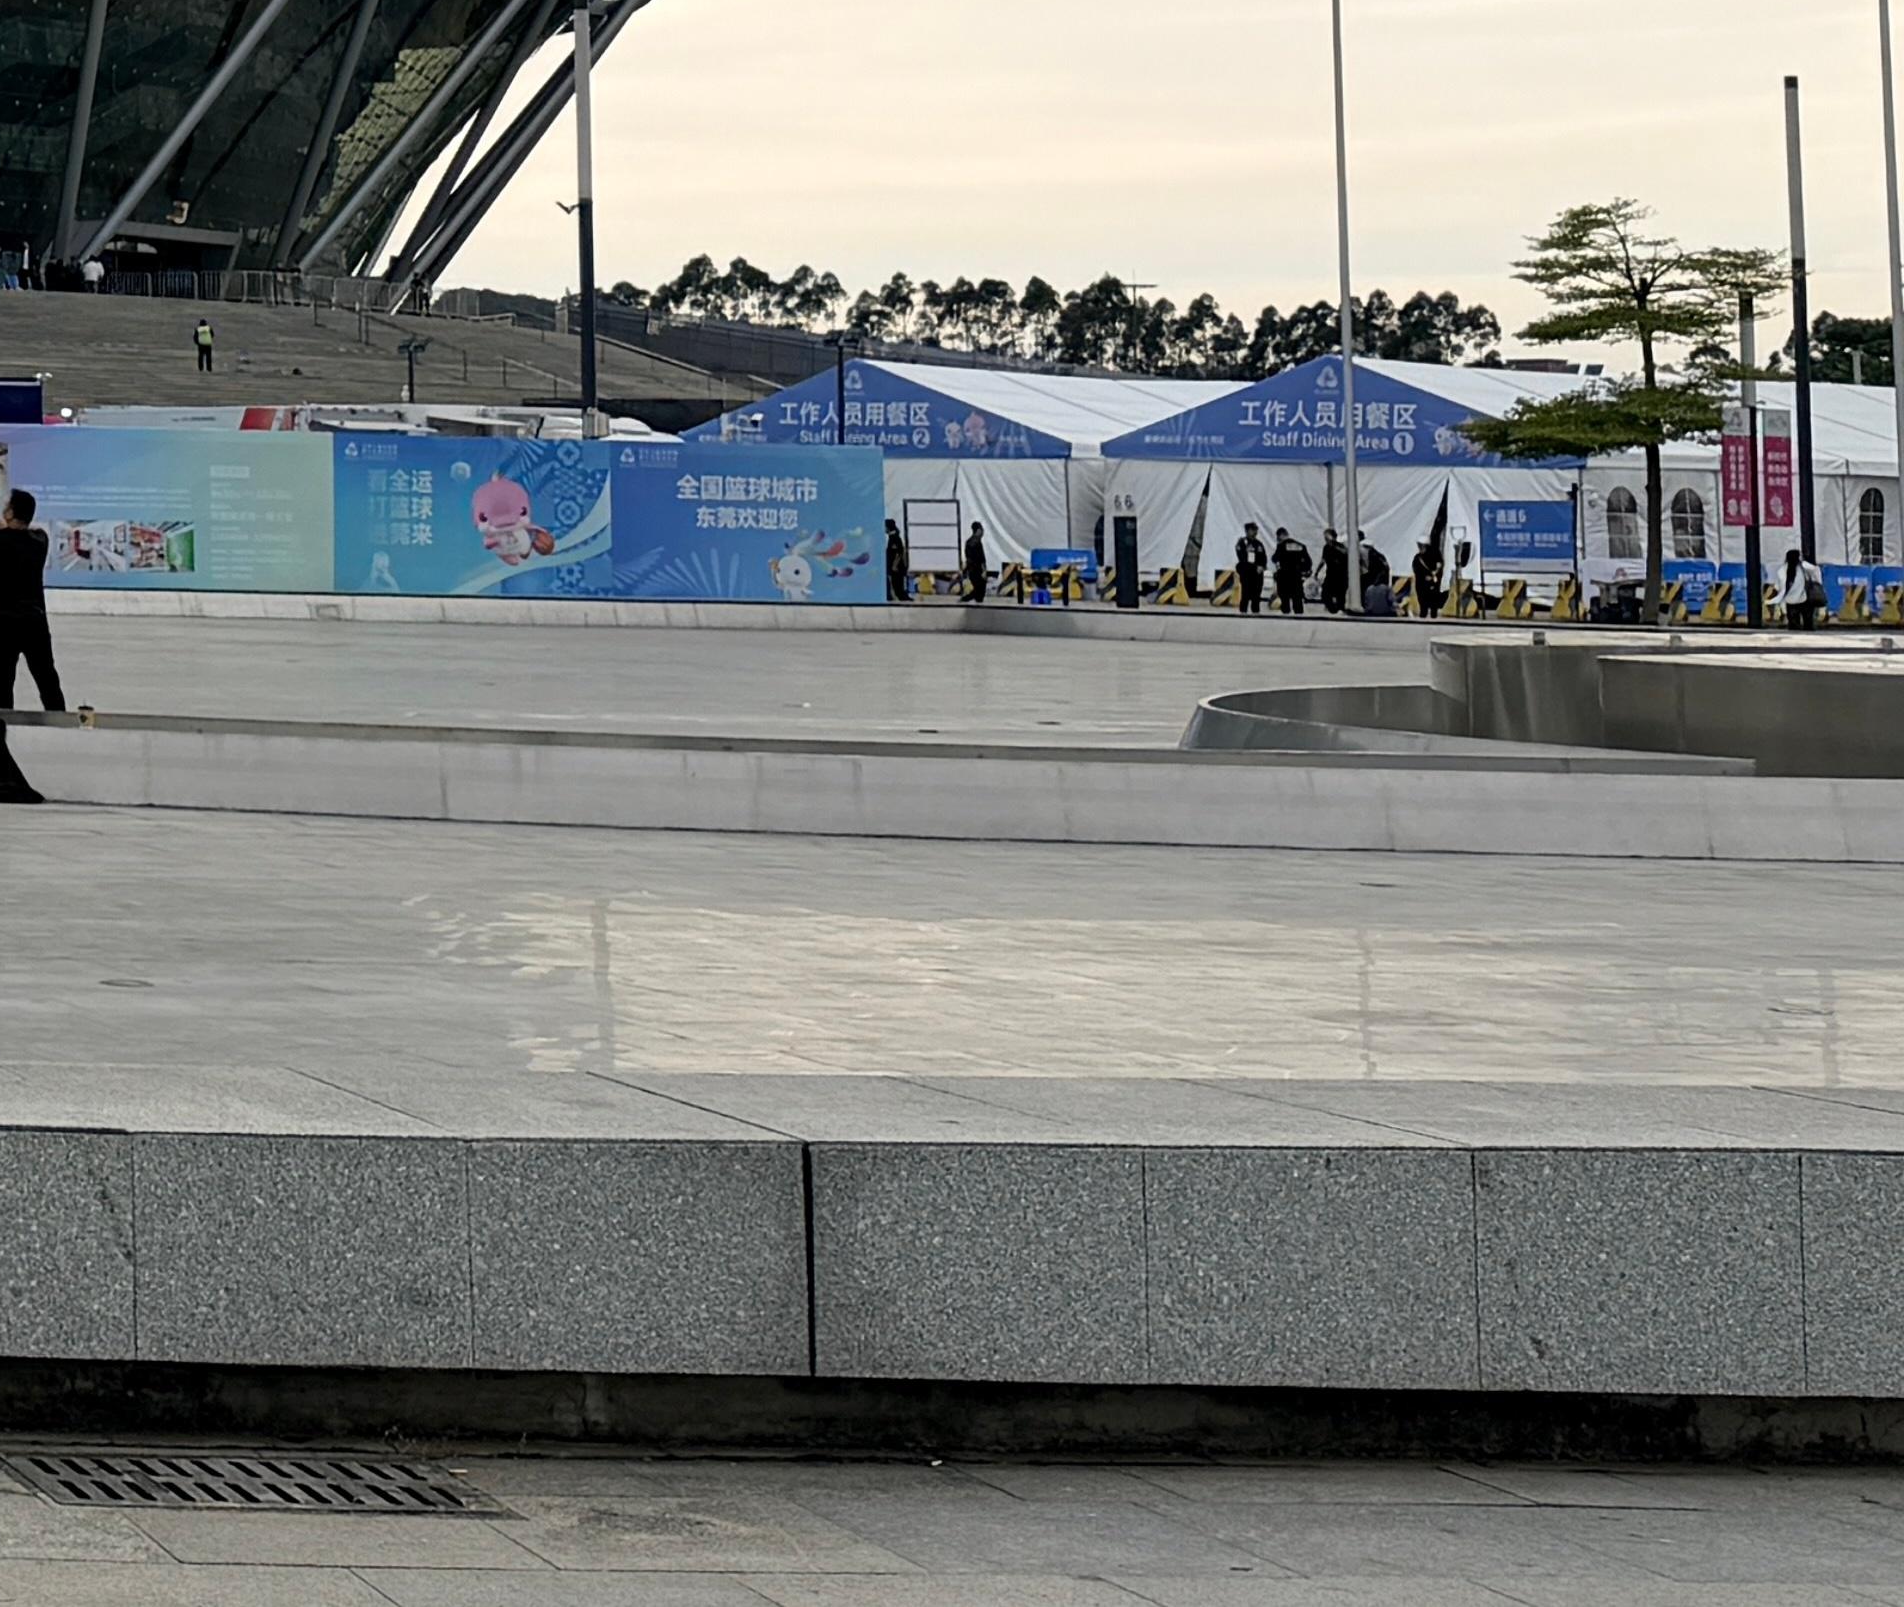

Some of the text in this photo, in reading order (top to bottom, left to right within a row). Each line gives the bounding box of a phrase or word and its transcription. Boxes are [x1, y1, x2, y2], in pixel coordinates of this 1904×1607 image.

[778, 401, 931, 426] 工作人员用餐区
[1238, 399, 1418, 429] 工作人员用餐区
[799, 429, 831, 444] Staff
[878, 431, 908, 445] Area
[1262, 431, 1298, 447] Staff
[1355, 434, 1389, 450] Area
[676, 474, 818, 502] 全国篮球城市
[696, 506, 799, 530] 东莞欢迎您
